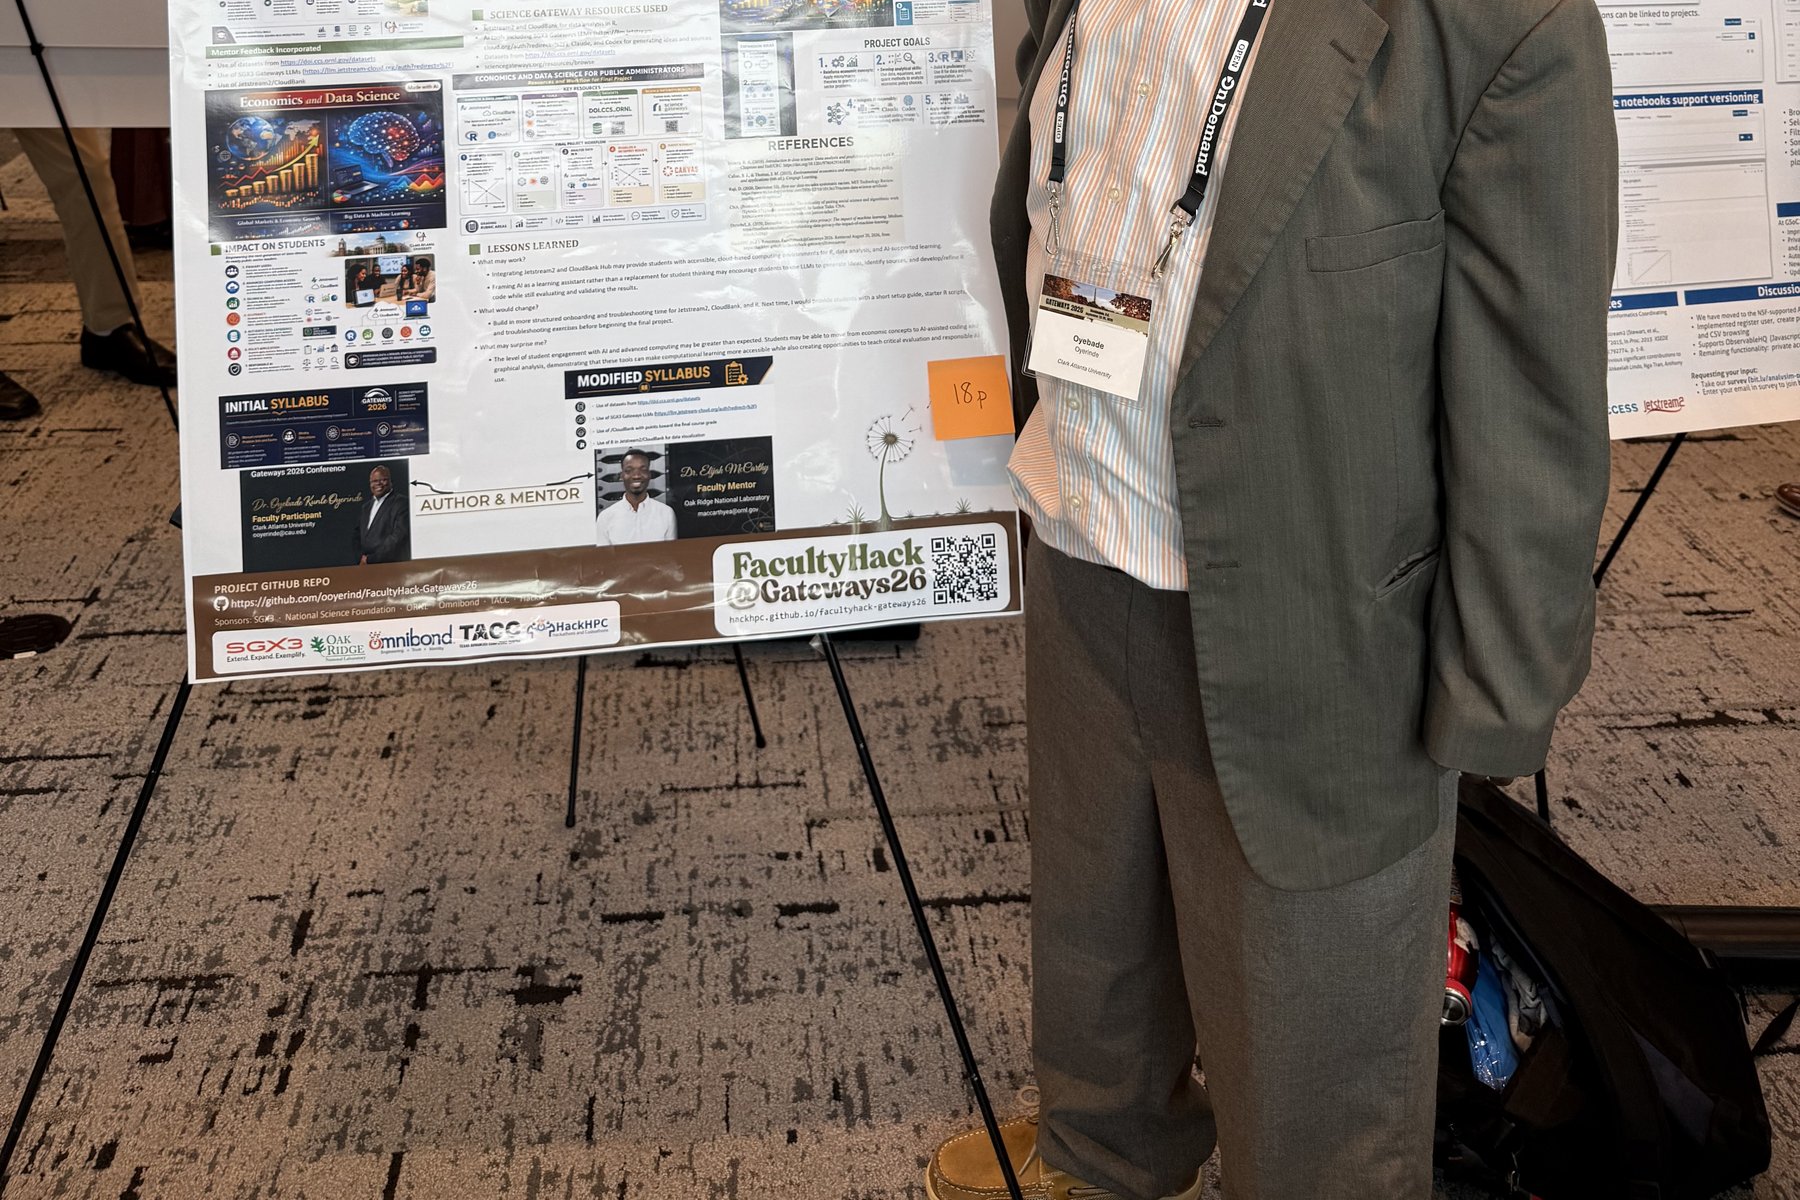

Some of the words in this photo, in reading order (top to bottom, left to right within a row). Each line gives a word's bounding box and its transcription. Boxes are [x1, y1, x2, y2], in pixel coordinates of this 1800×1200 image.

[864, 37, 900, 48] PROJECT
[902, 36, 929, 47] GOALS
[1230, 43, 1246, 69] OPEN
[241, 94, 302, 106] Economics
[305, 95, 322, 104] and
[325, 92, 352, 102] Data
[356, 90, 400, 101] Science
[1621, 95, 1670, 109] notebooks
[1672, 95, 1708, 107] support
[1709, 91, 1759, 106] versioning
[1195, 76, 1235, 176] OnDemand
[768, 136, 854, 151] REFERENCES
[225, 242, 259, 252] IMPACT
[262, 242, 275, 250] ON
[278, 238, 325, 249] STUDENTS
[488, 242, 529, 254] LESSONS
[533, 239, 579, 249] LEARNED
[1073, 334, 1104, 350] Oyebade
[1074, 346, 1100, 359] Oyerinde
[578, 370, 642, 387] MODIFIED
[645, 365, 710, 382] SYLLABUS
[1057, 358, 1070, 367] Clark
[1070, 361, 1088, 372] Atlanta
[1088, 365, 1112, 379] University
[226, 399, 268, 412] INITIAL
[270, 395, 328, 409] SYLLABUS
[250, 469, 285, 478] Gateways
[305, 464, 345, 473] Conference
[697, 482, 725, 493] Faculty
[727, 481, 756, 489] Mentor
[421, 494, 489, 511] AUTHOR
[495, 493, 504, 505] &
[510, 488, 578, 503] MENTOR
[697, 498, 712, 506] Ridge
[739, 494, 769, 502] Laboratory
[252, 514, 279, 523] Faculty
[281, 511, 321, 521] Participant
[732, 538, 922, 580] FacultyHack
[214, 582, 257, 593] PROJECT
[261, 579, 299, 590] GITHUB
[303, 577, 329, 586] REPO
[727, 566, 926, 609] @Gateways26
[556, 618, 607, 631] HackHPC
[226, 636, 302, 655] SGX3
[326, 634, 350, 645] OAK
[326, 643, 364, 656] RIDGE
